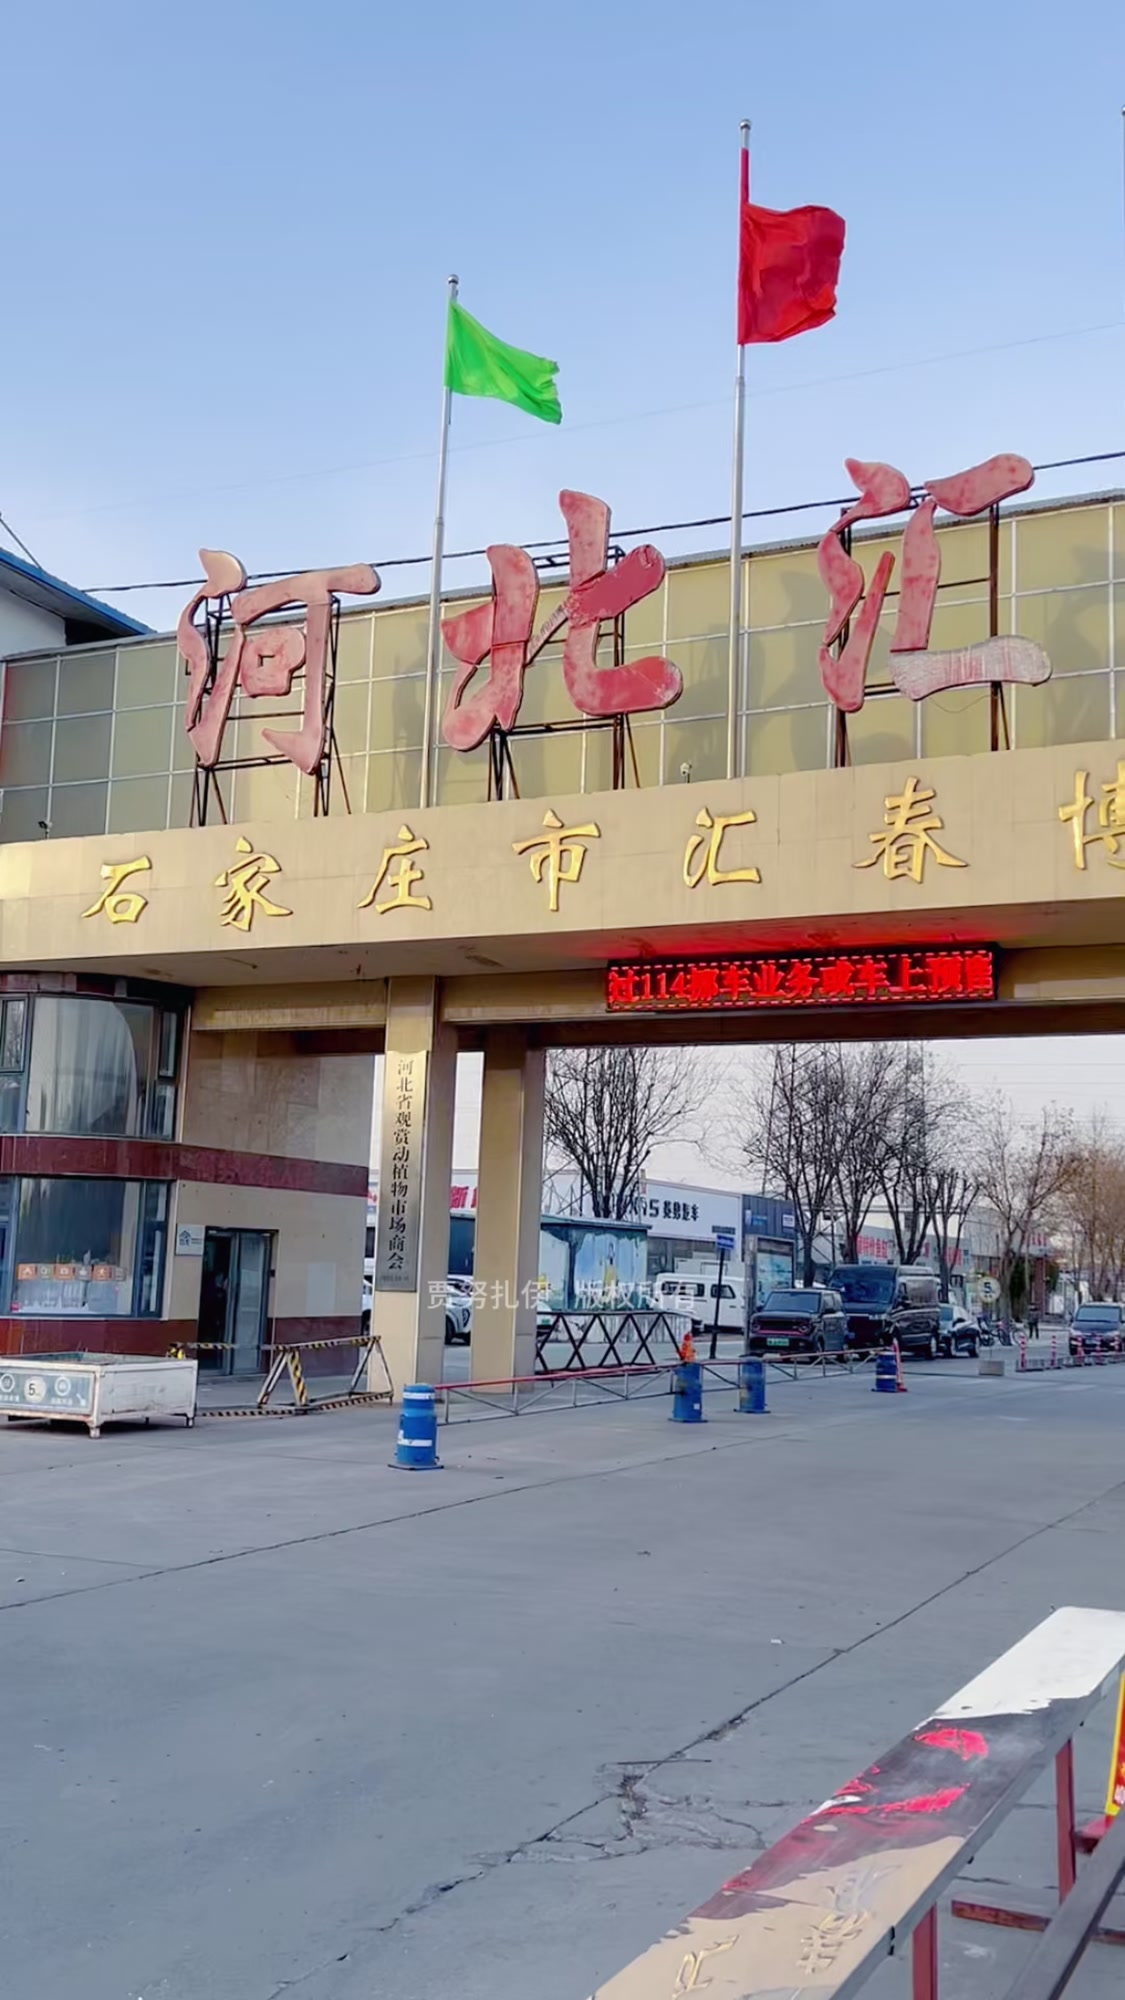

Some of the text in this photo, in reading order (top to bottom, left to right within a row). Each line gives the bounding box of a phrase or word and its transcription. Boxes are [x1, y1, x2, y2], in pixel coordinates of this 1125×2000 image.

[177, 453, 1053, 775] 河北汇
[387, 1059, 414, 1270] 河北省观赏动植物市场商会
[28, 1382, 37, 1397] 5
